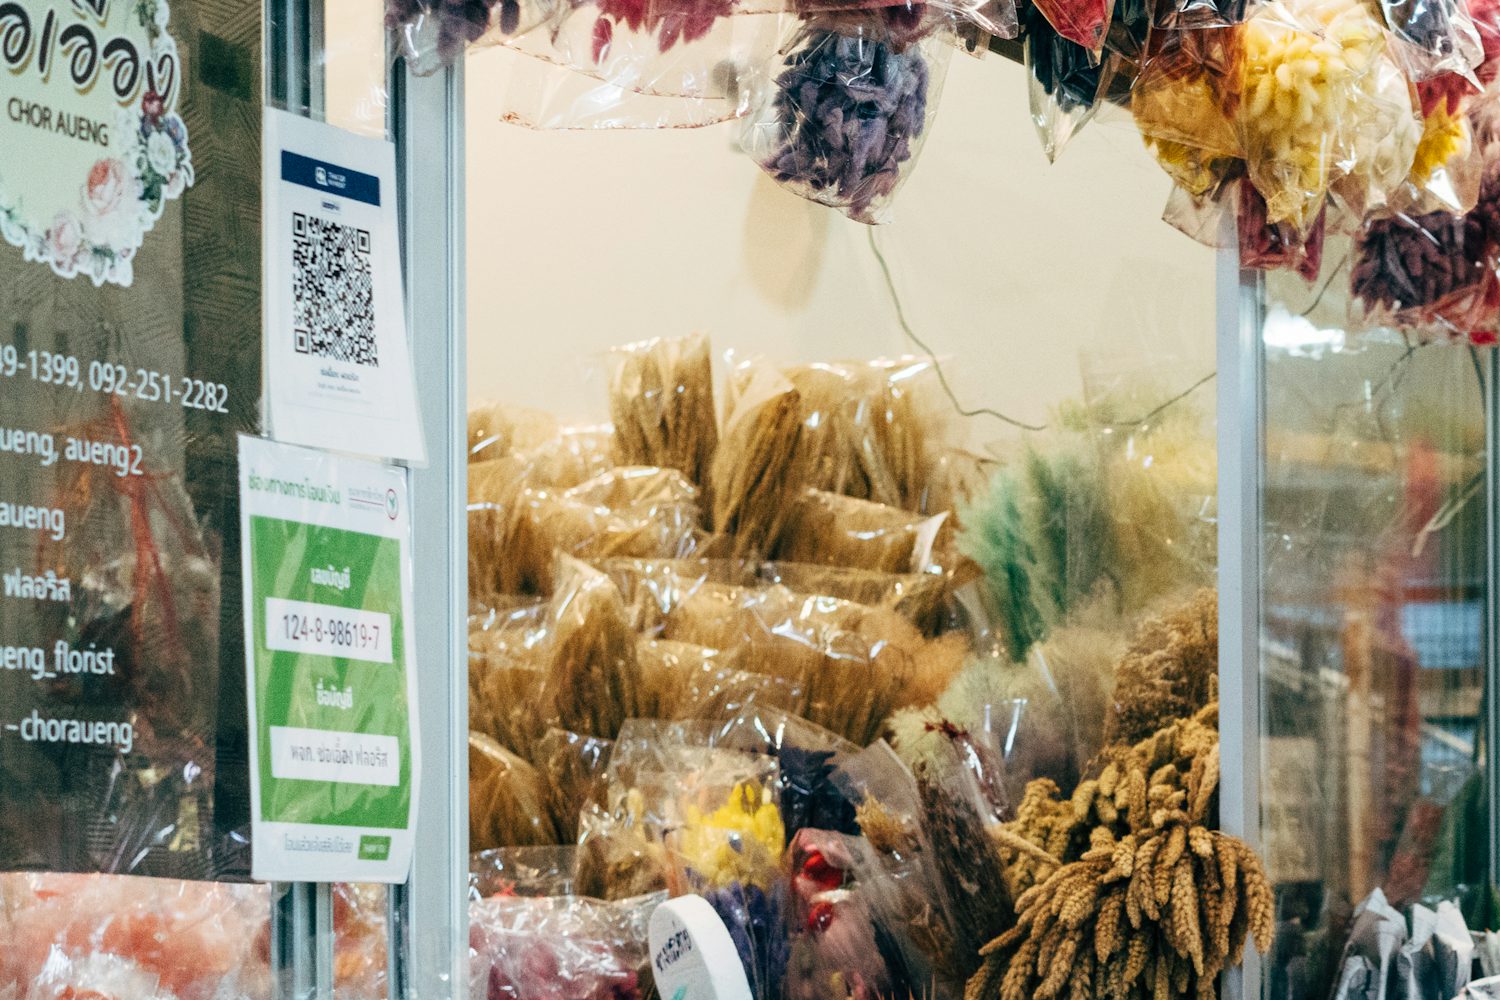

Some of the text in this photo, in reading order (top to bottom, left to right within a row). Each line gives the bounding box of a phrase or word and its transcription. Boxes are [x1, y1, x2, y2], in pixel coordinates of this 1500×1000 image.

[8, 97, 109, 147] CHOR AUENG
[0, 344, 229, 413] 9-1399, 092-251-2282
[65, 436, 143, 478] aueng2
[0, 501, 65, 541] aueng
[283, 614, 380, 649] 124-8-98619-7
[0, 640, 115, 680] eng_florist
